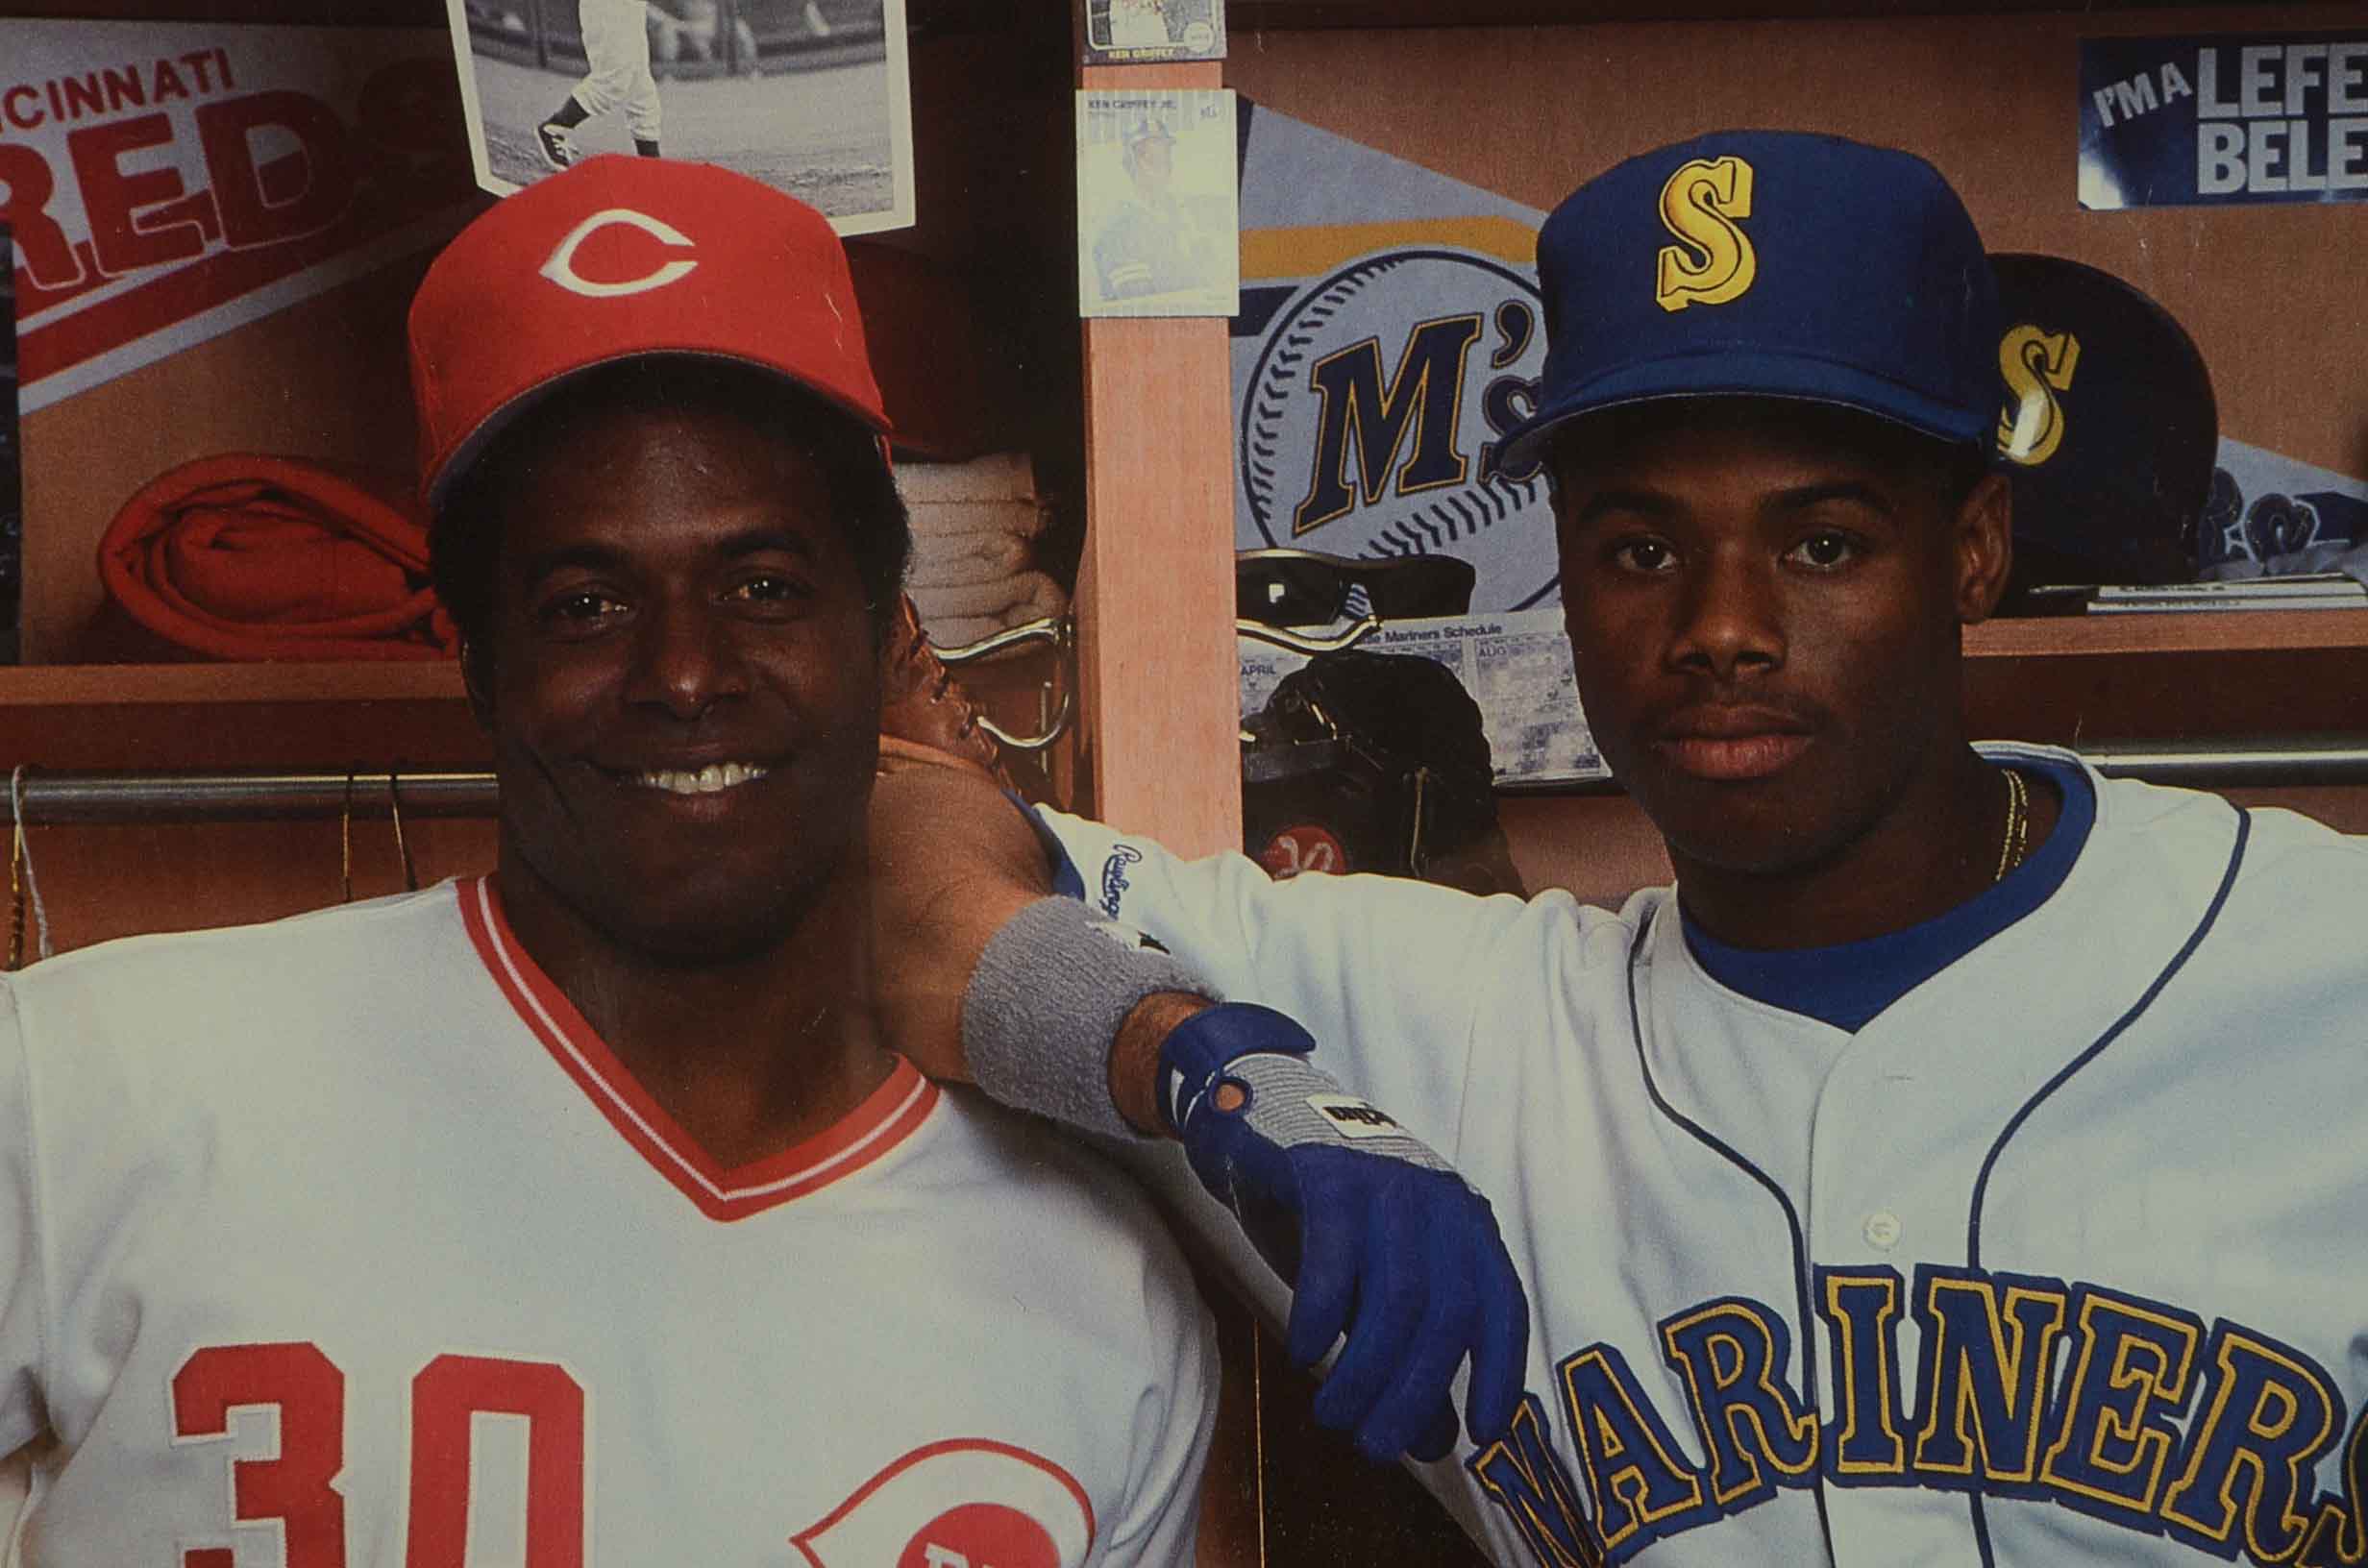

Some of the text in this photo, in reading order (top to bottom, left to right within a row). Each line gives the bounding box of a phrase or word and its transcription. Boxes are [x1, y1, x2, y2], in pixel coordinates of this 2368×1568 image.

[0, 46, 234, 135] CINNATI
[2092, 61, 2193, 128] I'M A
[538, 208, 699, 298] C
[1656, 155, 1757, 312] S
[1443, 625, 1503, 639] Schedule
[171, 1341, 582, 1568] 30
